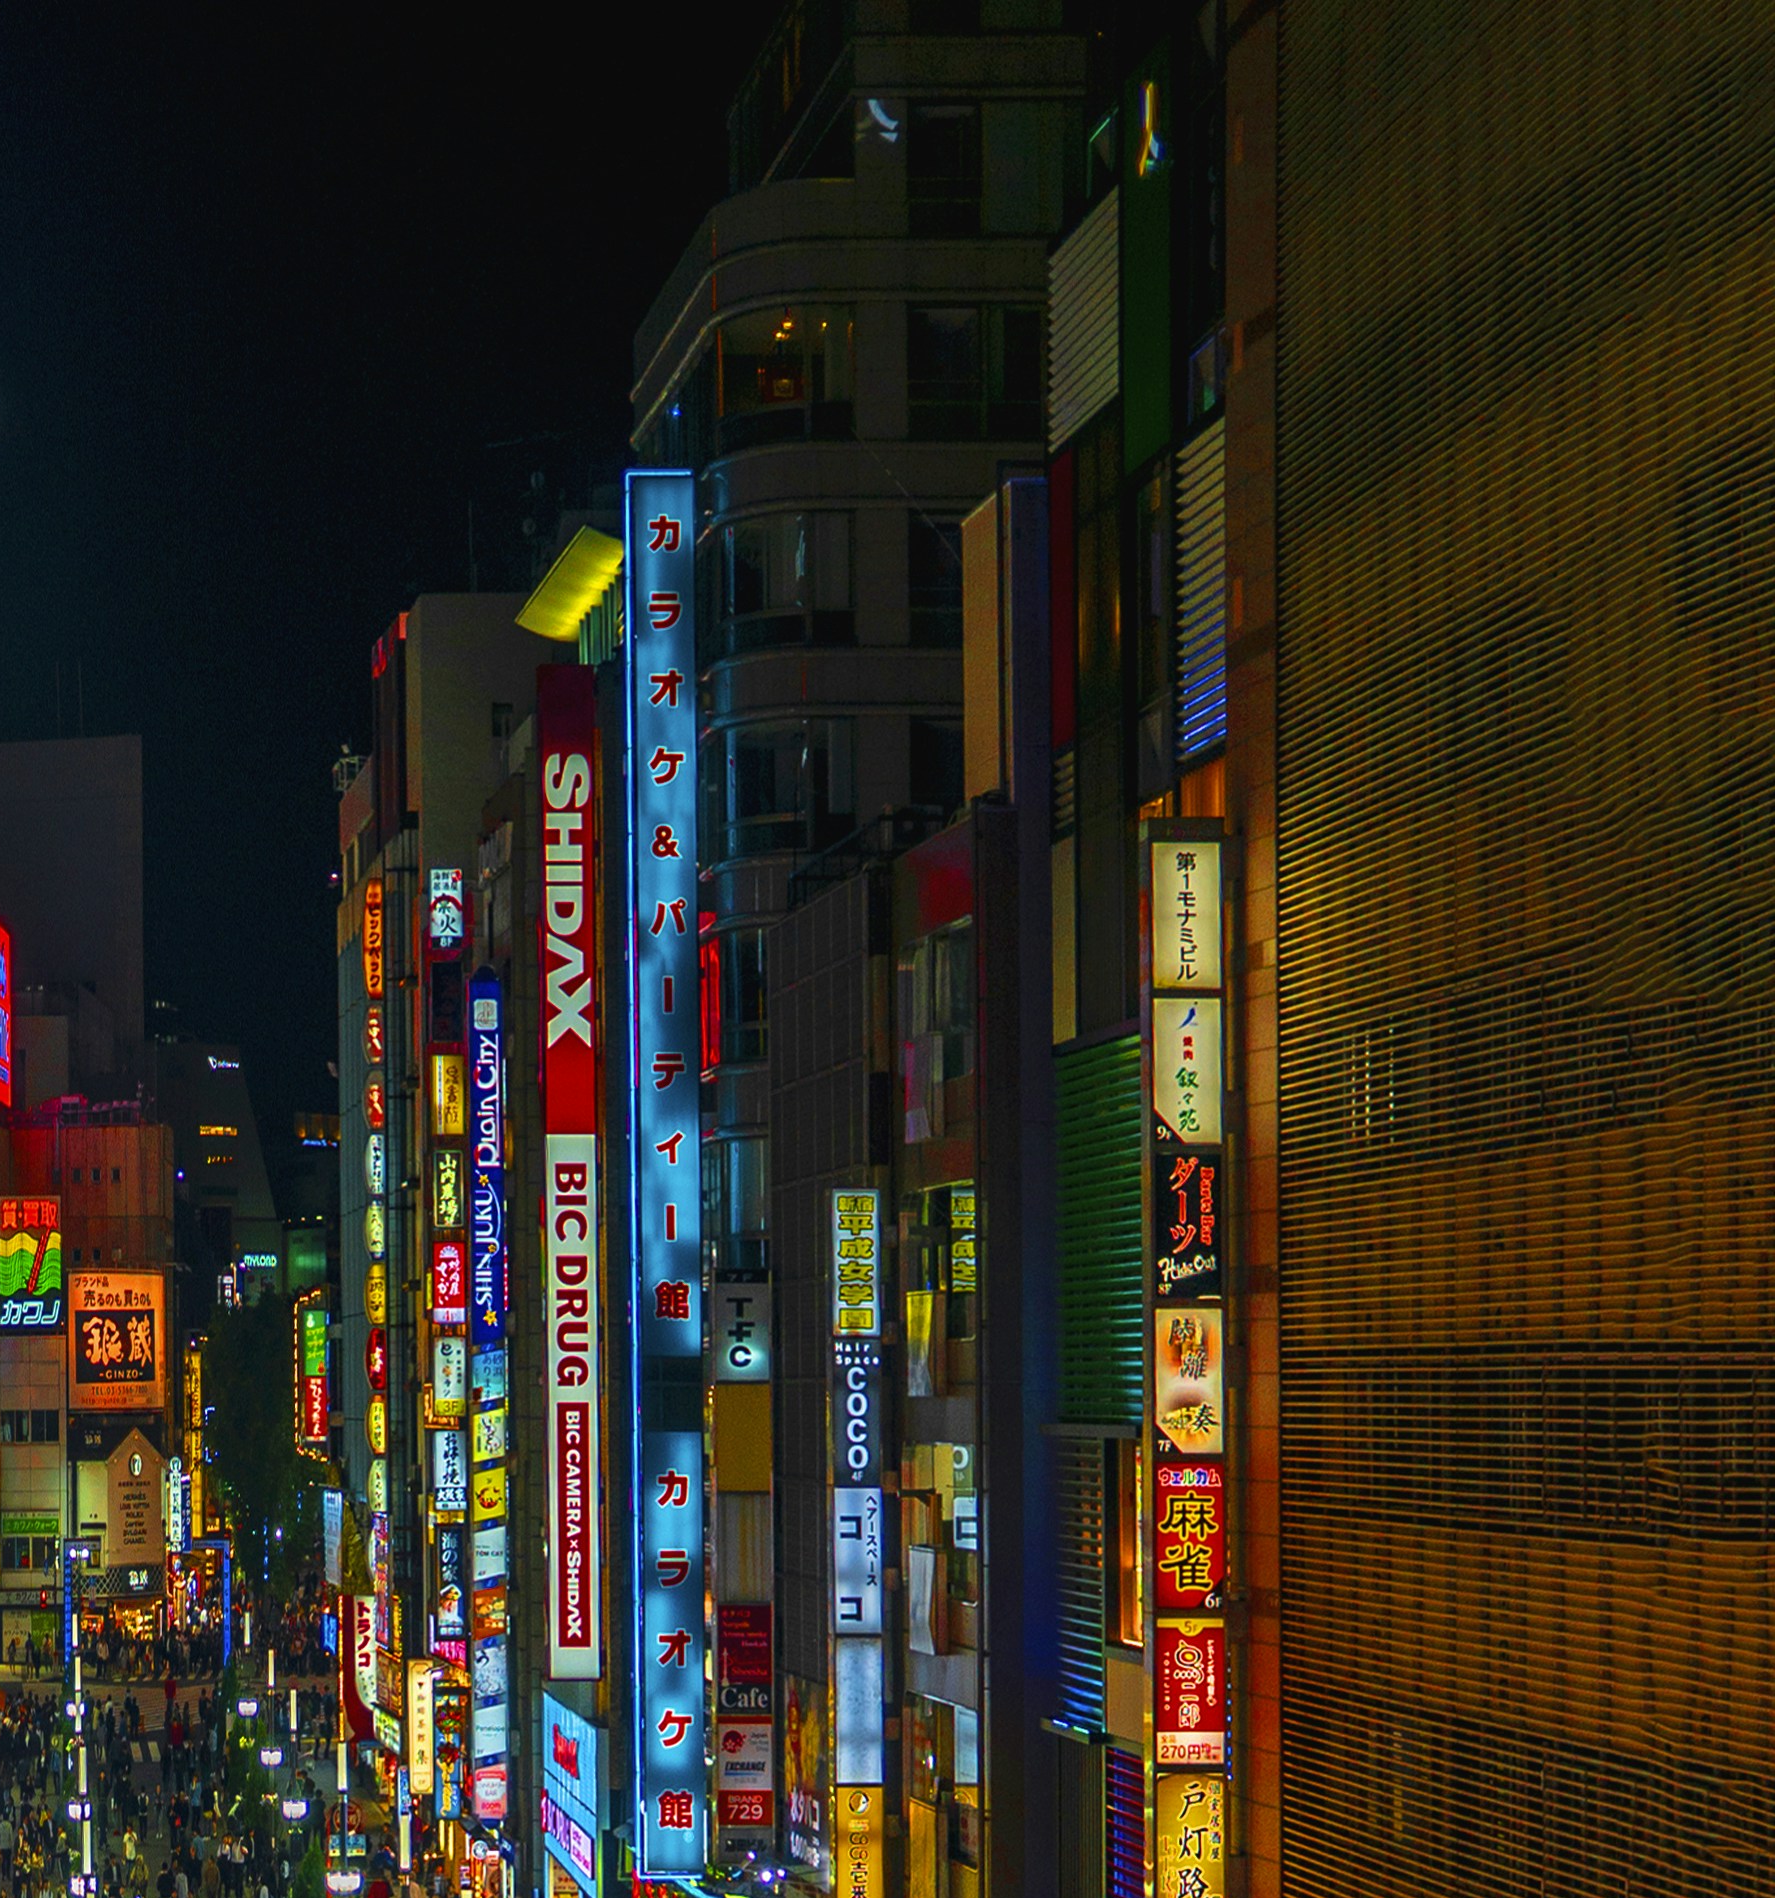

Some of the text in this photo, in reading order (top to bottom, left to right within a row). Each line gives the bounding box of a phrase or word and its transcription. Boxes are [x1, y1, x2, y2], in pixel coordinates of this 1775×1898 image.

[544, 753, 592, 1048] SHIDAX
[648, 515, 690, 1320] カラオケ&パーティー館
[1169, 1157, 1198, 1254] ダーツ
[0, 1300, 60, 1324] カワノ
[74, 1276, 110, 1289] ブランド品
[555, 1163, 588, 1386] BIC DRUG
[835, 1342, 869, 1351] Hair
[836, 1355, 878, 1365] Space
[847, 1367, 868, 1468] COCO
[1159, 1468, 1221, 1487] ウェルカム
[566, 1411, 581, 1638] BIC CAMERA SHIDAX
[866, 1496, 877, 1586] ヘアースペース
[1158, 1490, 1219, 1592] 麻雀
[840, 1516, 862, 1621] ココ
[356, 1601, 371, 1668] トラノコ
[657, 1469, 693, 1829] カラオケ館
[721, 1688, 767, 1708] Cafe
[725, 1762, 765, 1775] EXCHANGE
[728, 1795, 763, 1803] BRAND
[729, 1805, 762, 1820] 729
